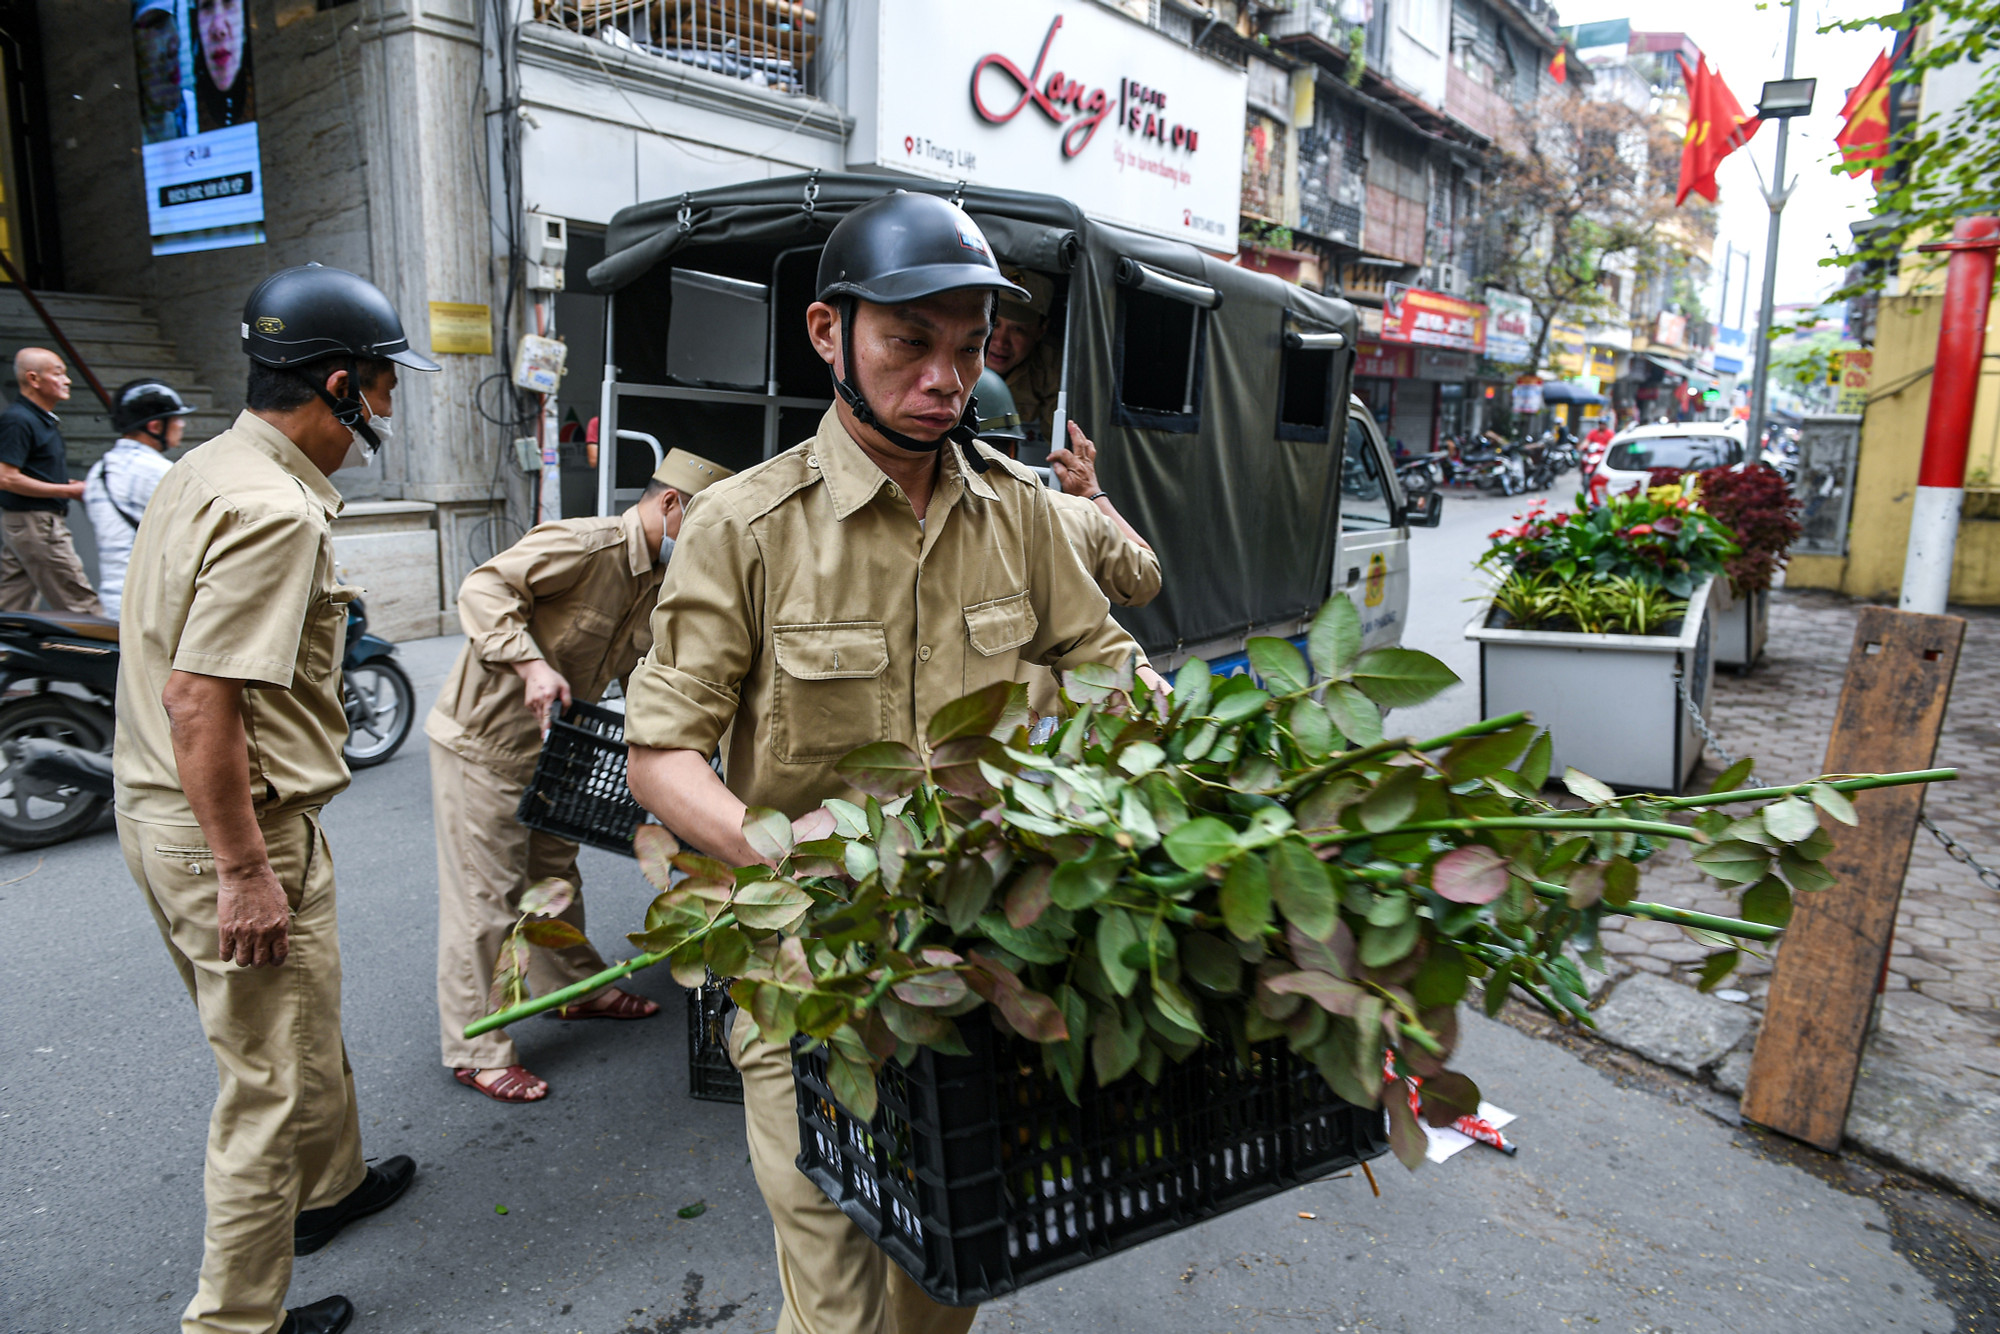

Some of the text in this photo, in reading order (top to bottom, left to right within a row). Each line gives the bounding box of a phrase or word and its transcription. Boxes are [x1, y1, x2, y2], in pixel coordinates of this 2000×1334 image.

[971, 14, 1117, 158] Long
[1130, 81, 1167, 109] HAIR
[1129, 106, 1198, 151] SALON
[915, 136, 922, 155] 8
[925, 139, 954, 168] Trung
